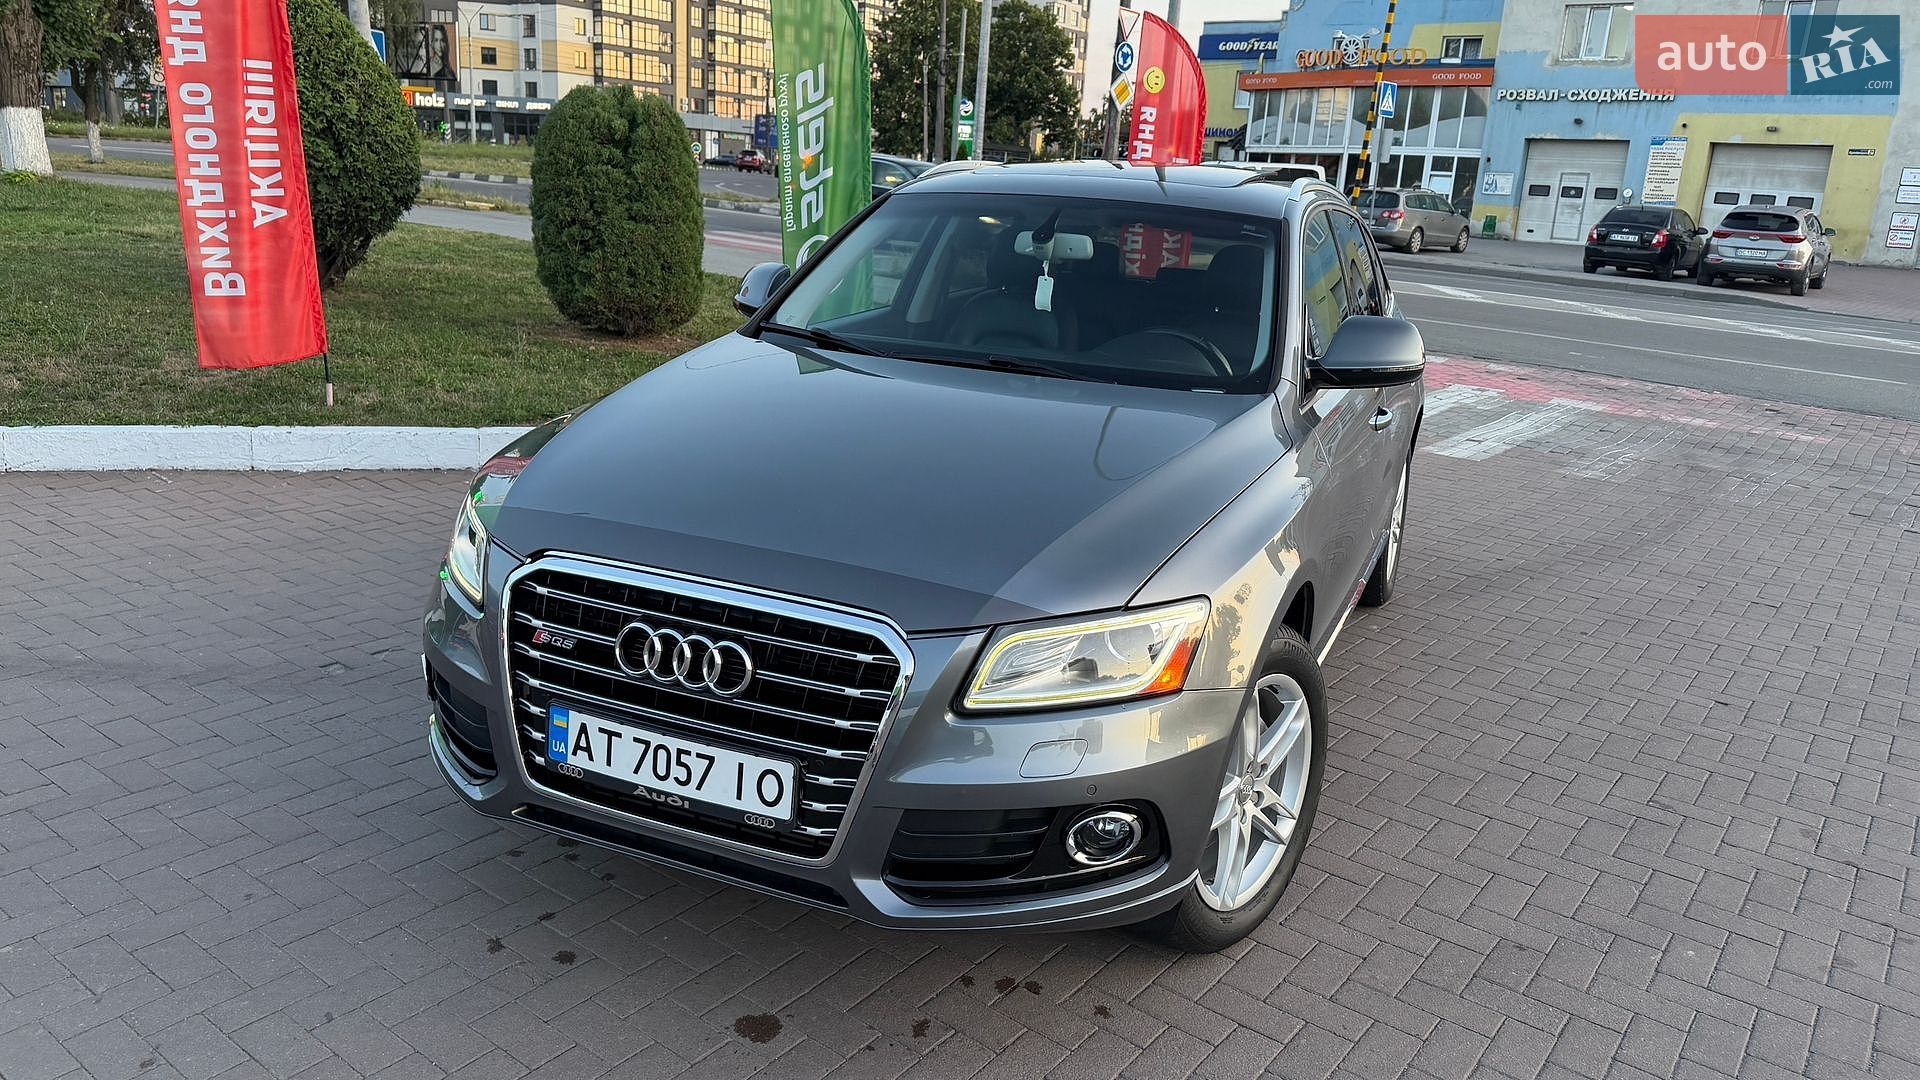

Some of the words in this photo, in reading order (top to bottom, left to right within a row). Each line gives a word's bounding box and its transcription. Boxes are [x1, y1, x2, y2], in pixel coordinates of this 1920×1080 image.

[1218, 37, 1279, 54] GOODYEAR
[1296, 49, 1344, 69] GOOD
[1432, 72, 1456, 81] GOOD
[1458, 72, 1482, 81] FOOD
[415, 91, 446, 108] holz
[1496, 87, 1676, 103] РОЗВАЛ-СХОДЖЕННЯ
[552, 740, 567, 755] UA
[571, 721, 622, 768] AT
[632, 736, 716, 791] 7057
[736, 762, 784, 808] IO
[632, 785, 690, 809] Audi
